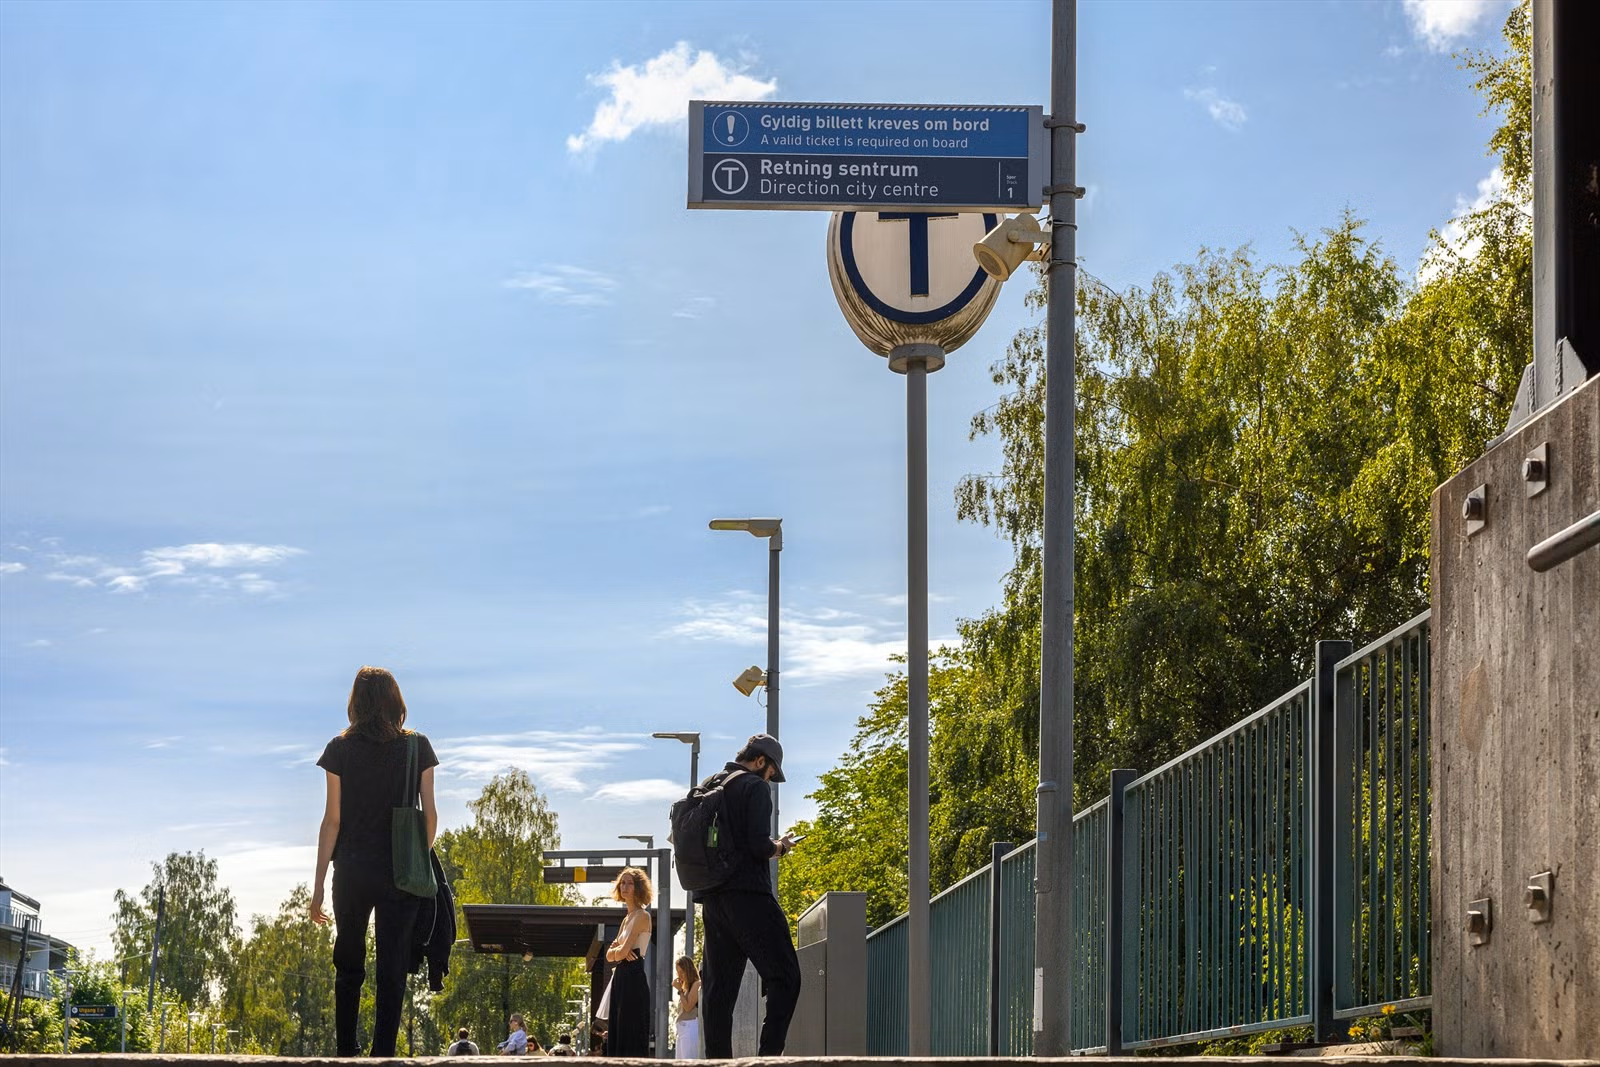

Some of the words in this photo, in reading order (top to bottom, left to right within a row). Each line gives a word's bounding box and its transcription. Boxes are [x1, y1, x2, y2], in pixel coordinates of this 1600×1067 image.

[760, 114, 811, 132] Gyldig
[816, 115, 863, 130] billett
[868, 116, 920, 130] kreves
[924, 119, 948, 131] om
[952, 117, 990, 131] bord
[760, 134, 769, 145] A
[773, 134, 802, 146] valid
[806, 134, 840, 147] ticket
[844, 135, 854, 147] is
[857, 136, 910, 149] required
[913, 138, 929, 148] on
[932, 137, 968, 149] board
[721, 167, 739, 190] T
[760, 159, 832, 179] Retning
[838, 161, 919, 177] sentrum
[760, 178, 840, 195] Direction
[846, 180, 877, 200] city
[883, 182, 939, 197] centre
[1007, 187, 1013, 199] 1
[877, 211, 959, 296] T
